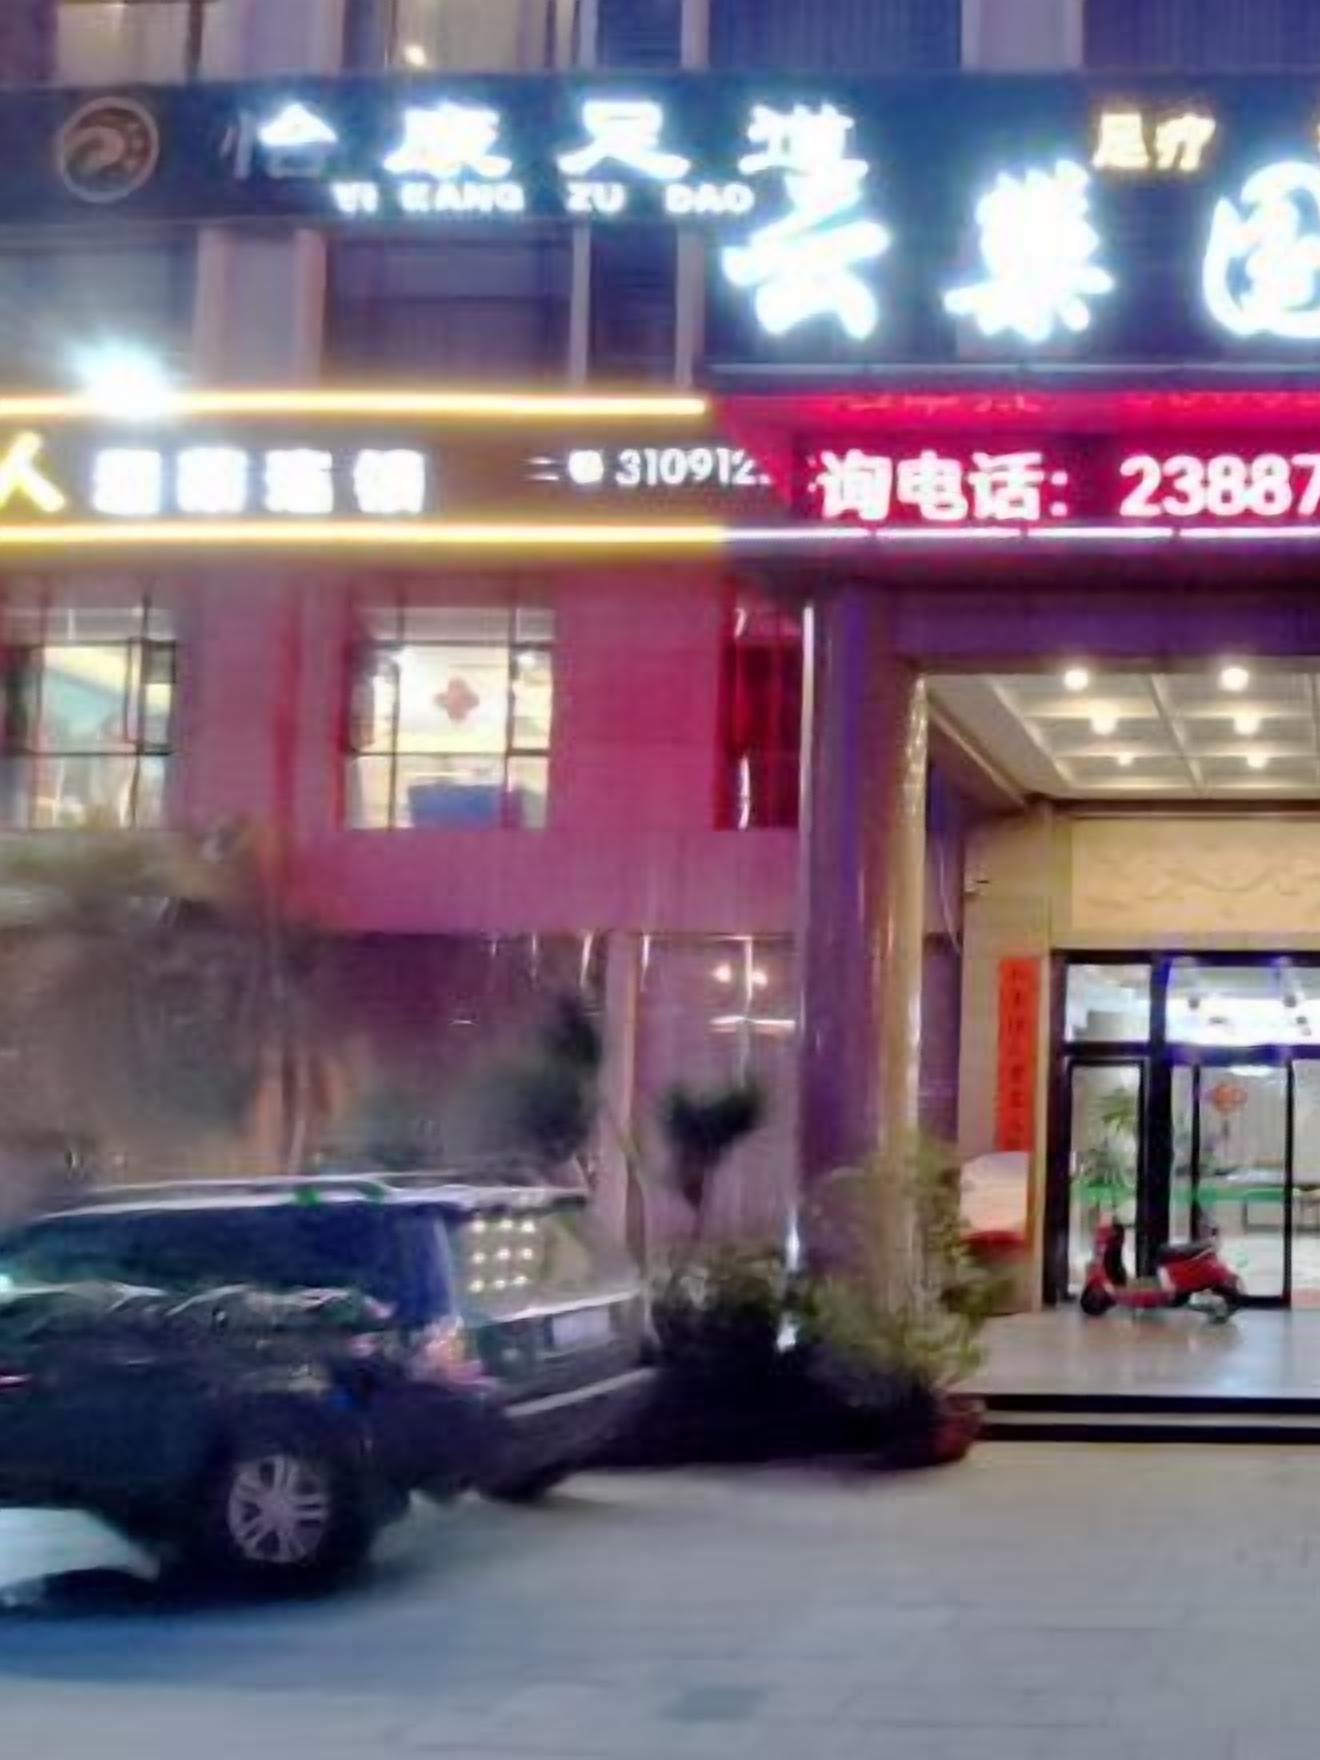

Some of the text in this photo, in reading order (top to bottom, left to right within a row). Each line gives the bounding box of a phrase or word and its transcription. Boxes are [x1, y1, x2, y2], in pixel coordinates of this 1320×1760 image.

[400, 182, 525, 214] KANG
[563, 182, 629, 214] ZU
[664, 182, 756, 214] DAO
[615, 447, 772, 487] 310912
[807, 448, 1068, 521] 询电话:
